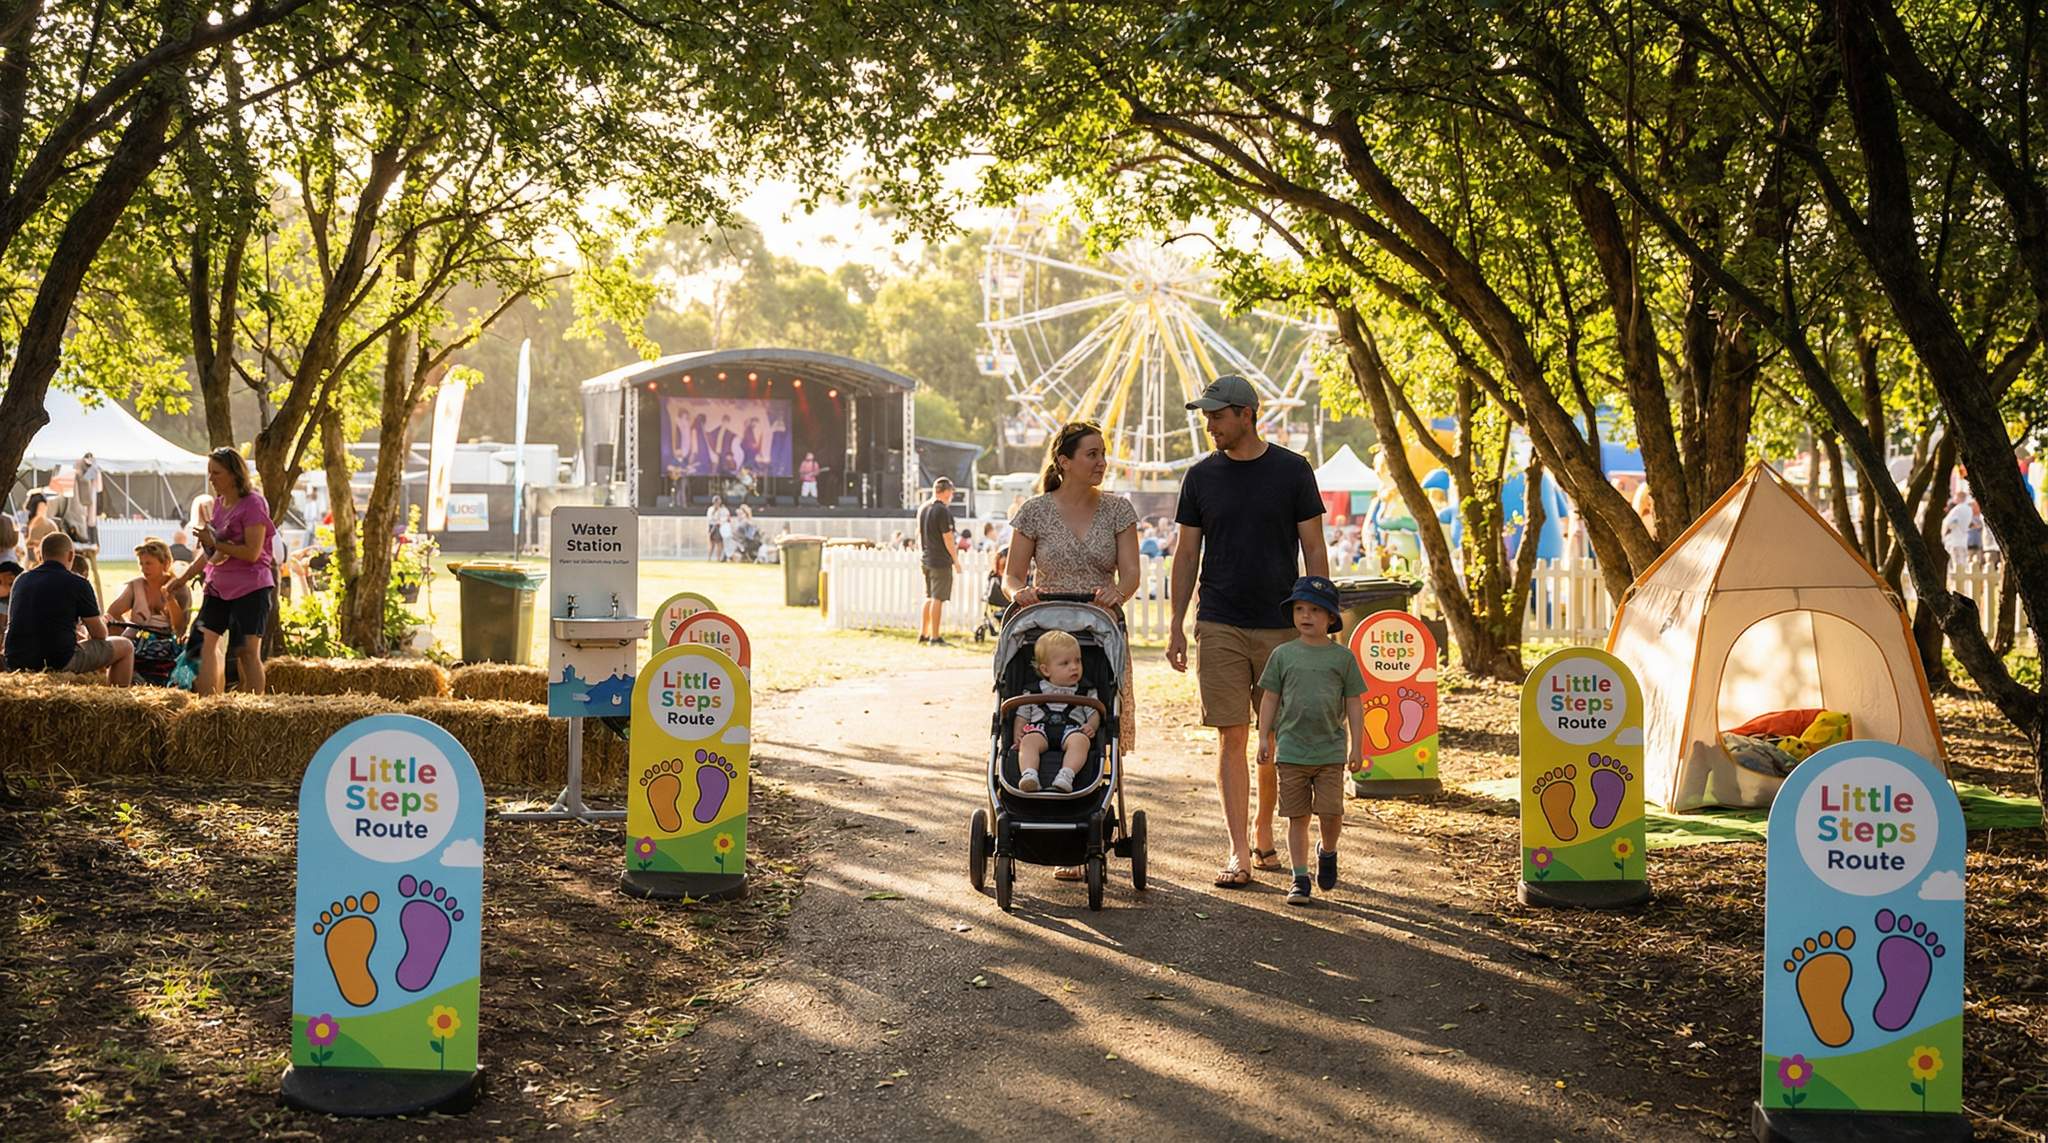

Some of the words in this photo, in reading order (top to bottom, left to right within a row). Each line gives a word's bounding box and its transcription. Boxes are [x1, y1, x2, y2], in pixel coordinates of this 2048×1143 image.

[571, 523, 618, 535] Water
[567, 539, 621, 552] Station
[670, 607, 698, 620] Litt
[689, 630, 730, 644] Little
[1371, 630, 1414, 643] Little
[1370, 645, 1415, 660] Steps
[1375, 661, 1410, 671] Route
[663, 671, 721, 690] Little
[1552, 674, 1611, 692] Little
[661, 690, 722, 712] Steps
[1551, 694, 1614, 715] Steps
[667, 712, 715, 725] Route
[1558, 716, 1607, 729] Route
[350, 755, 437, 784] Little
[346, 784, 439, 817] Steps
[1821, 784, 1914, 813] Little
[355, 818, 428, 839] Route
[1817, 815, 1917, 848] Steps
[1828, 849, 1905, 870] Route
